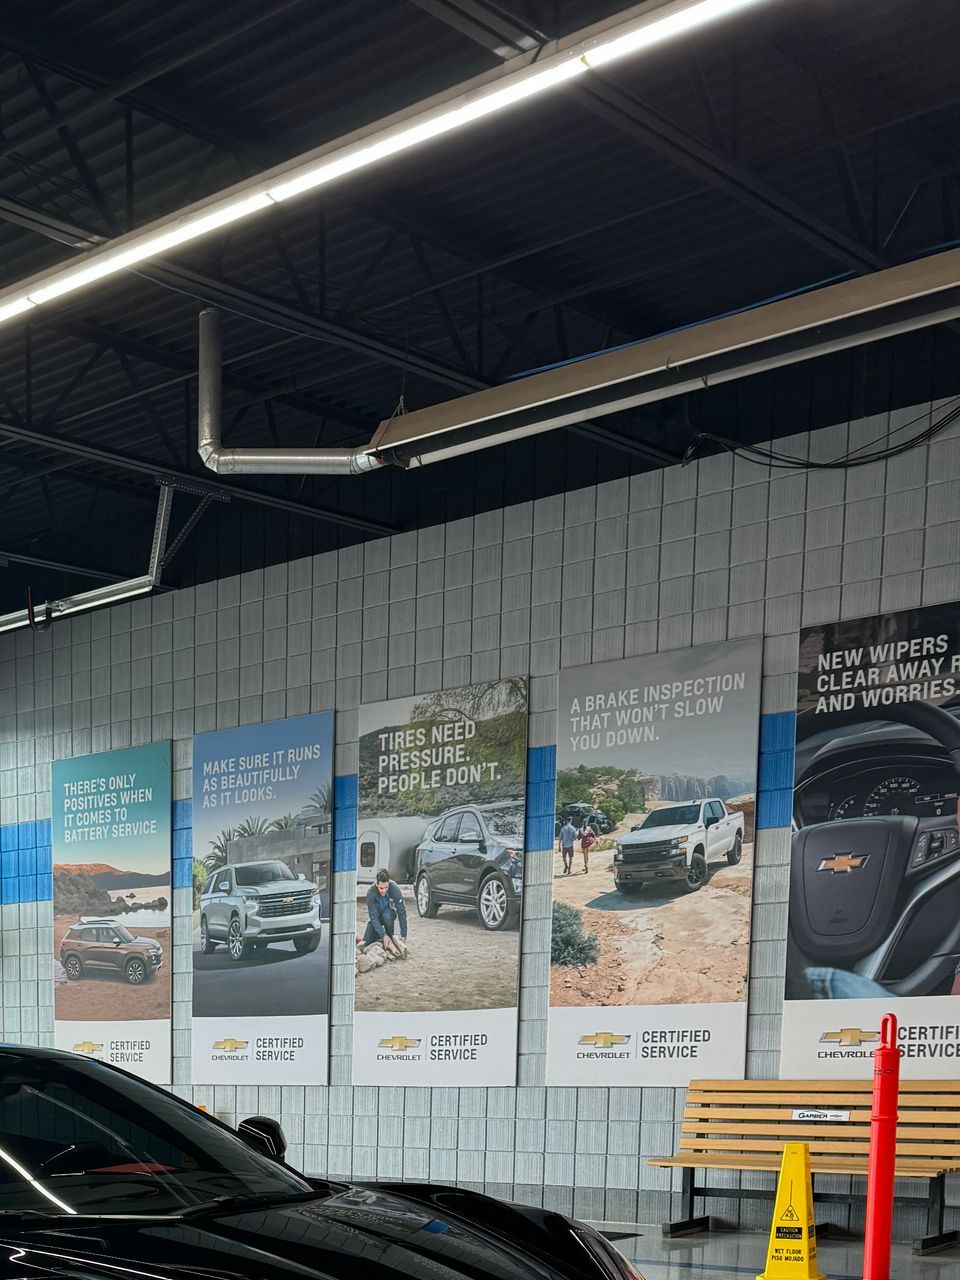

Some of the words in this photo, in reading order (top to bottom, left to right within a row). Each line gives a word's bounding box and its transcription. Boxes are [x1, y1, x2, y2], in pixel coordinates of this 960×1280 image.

[818, 647, 864, 672] NEW
[869, 634, 948, 664] WIPERS
[817, 667, 880, 693] CLEAR
[885, 656, 945, 684] AWAY
[570, 698, 581, 714] A
[585, 688, 639, 712] BRAKE
[643, 672, 746, 703] INSPECTION
[815, 692, 855, 714] AND
[570, 712, 611, 733] THAT
[615, 703, 670, 727] WON'T
[674, 695, 725, 718] SLOW
[379, 728, 426, 751] TIRES
[432, 720, 476, 744] NEED
[570, 733, 601, 752] YOU
[606, 725, 660, 748] DOWN.
[203, 758, 236, 776] MAKE
[239, 753, 270, 771] SURE
[273, 750, 285, 766] IT
[288, 744, 321, 763] RUNS
[379, 744, 470, 773] PRESSURE.
[64, 778, 106, 796] THERE'S
[109, 773, 136, 790] ONLY
[203, 778, 218, 792] AS
[221, 765, 300, 789] BEAUTIFULLY
[378, 769, 441, 794] PEOPLE
[446, 762, 501, 786] DON'T.
[64, 792, 117, 812] POSITIVES
[120, 788, 152, 805] WHEN
[202, 794, 217, 808] AS
[221, 792, 231, 806] IT
[235, 786, 277, 804] LOOKS.
[64, 814, 74, 827] IT
[76, 809, 112, 826] COMES
[114, 807, 127, 821] TO
[64, 825, 109, 843] BATTERY
[112, 820, 157, 838] SERVICE
[110, 1040, 151, 1050] CERTIFIED
[256, 1038, 304, 1048] CERTIFIED
[431, 1034, 488, 1047] CERTIFIED
[642, 1030, 710, 1043] CERTIFIED
[110, 1052, 144, 1062] SERVICE
[256, 1050, 295, 1061] SERVICE
[430, 1049, 477, 1061] SERVICE
[641, 1046, 698, 1058] SERVICE
